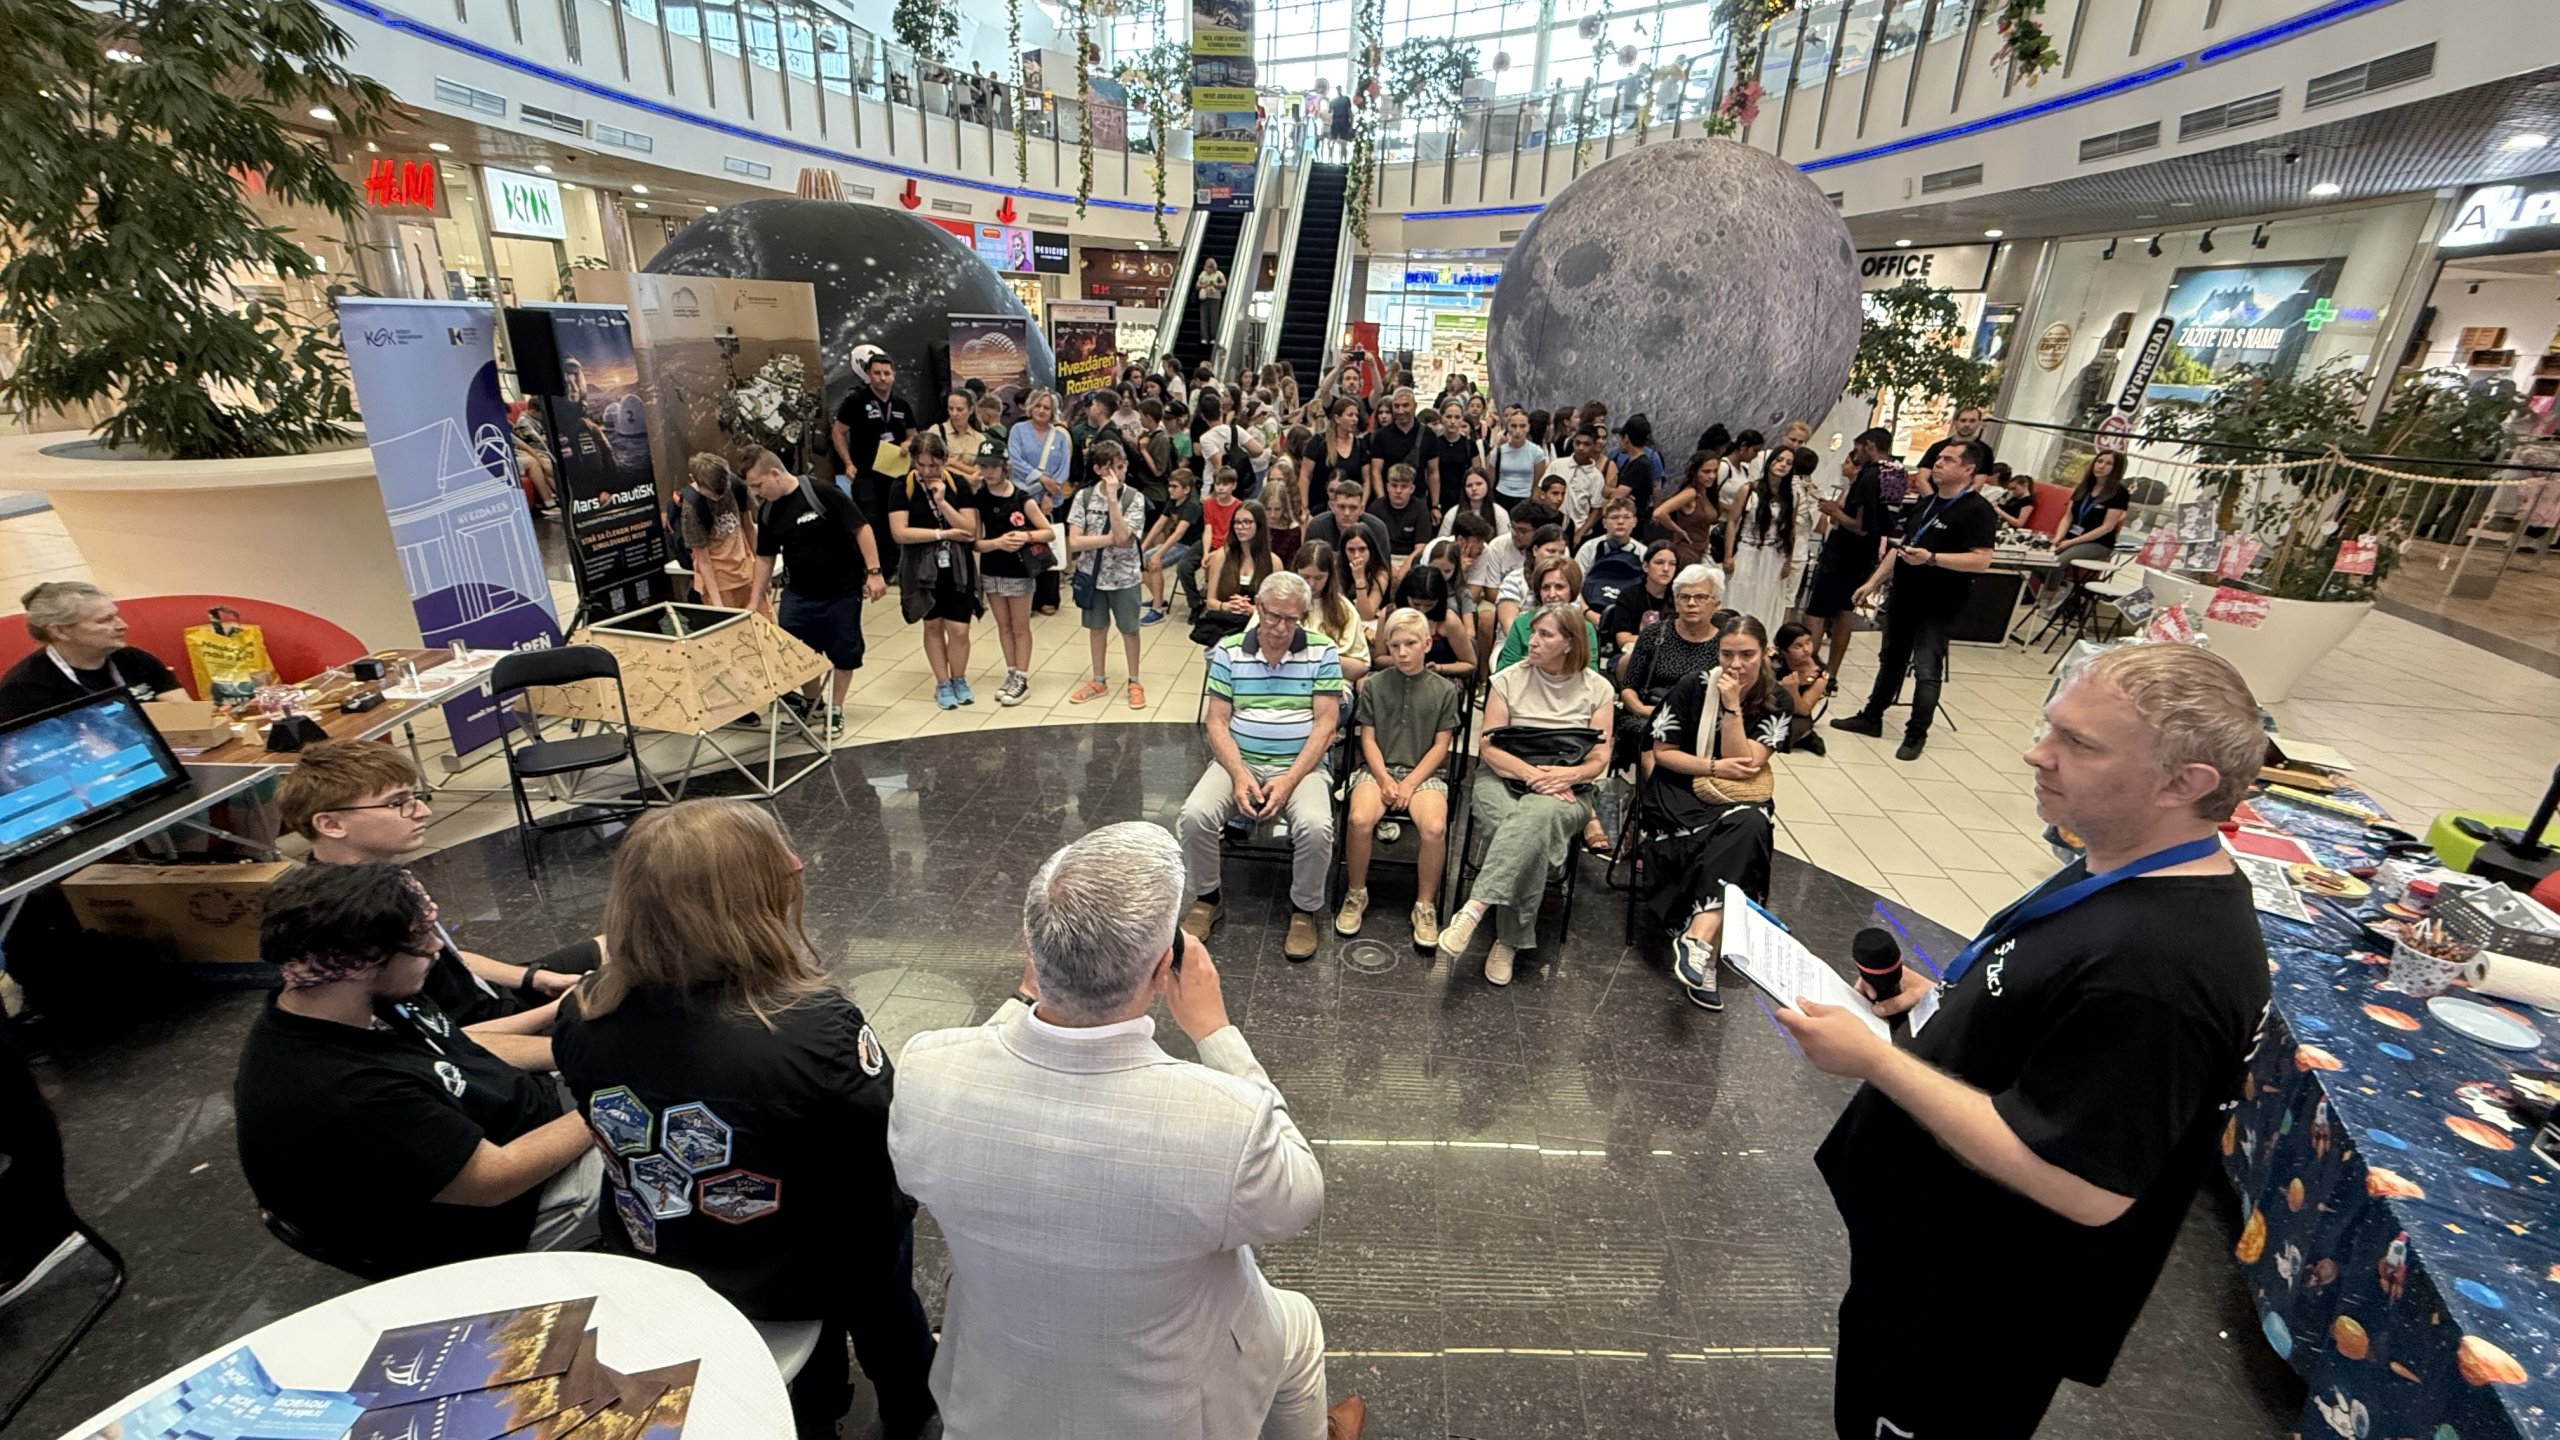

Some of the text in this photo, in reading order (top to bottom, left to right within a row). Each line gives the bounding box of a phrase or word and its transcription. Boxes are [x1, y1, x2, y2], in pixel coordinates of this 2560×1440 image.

[362, 159, 435, 211] H&M
[1035, 245, 1068, 256] MEDICINE
[1861, 254, 1934, 278] OFFICE
[1406, 271, 1438, 284] BENU
[2040, 343, 2067, 352] EXPERT
[2177, 324, 2285, 349] ZAŽITE TO S NAMI!
[1058, 352, 1115, 378] Hvezdáreň
[2122, 322, 2170, 406] VÝPREDAJ
[1066, 375, 1112, 395] Rožňava
[626, 410, 635, 423] 2
